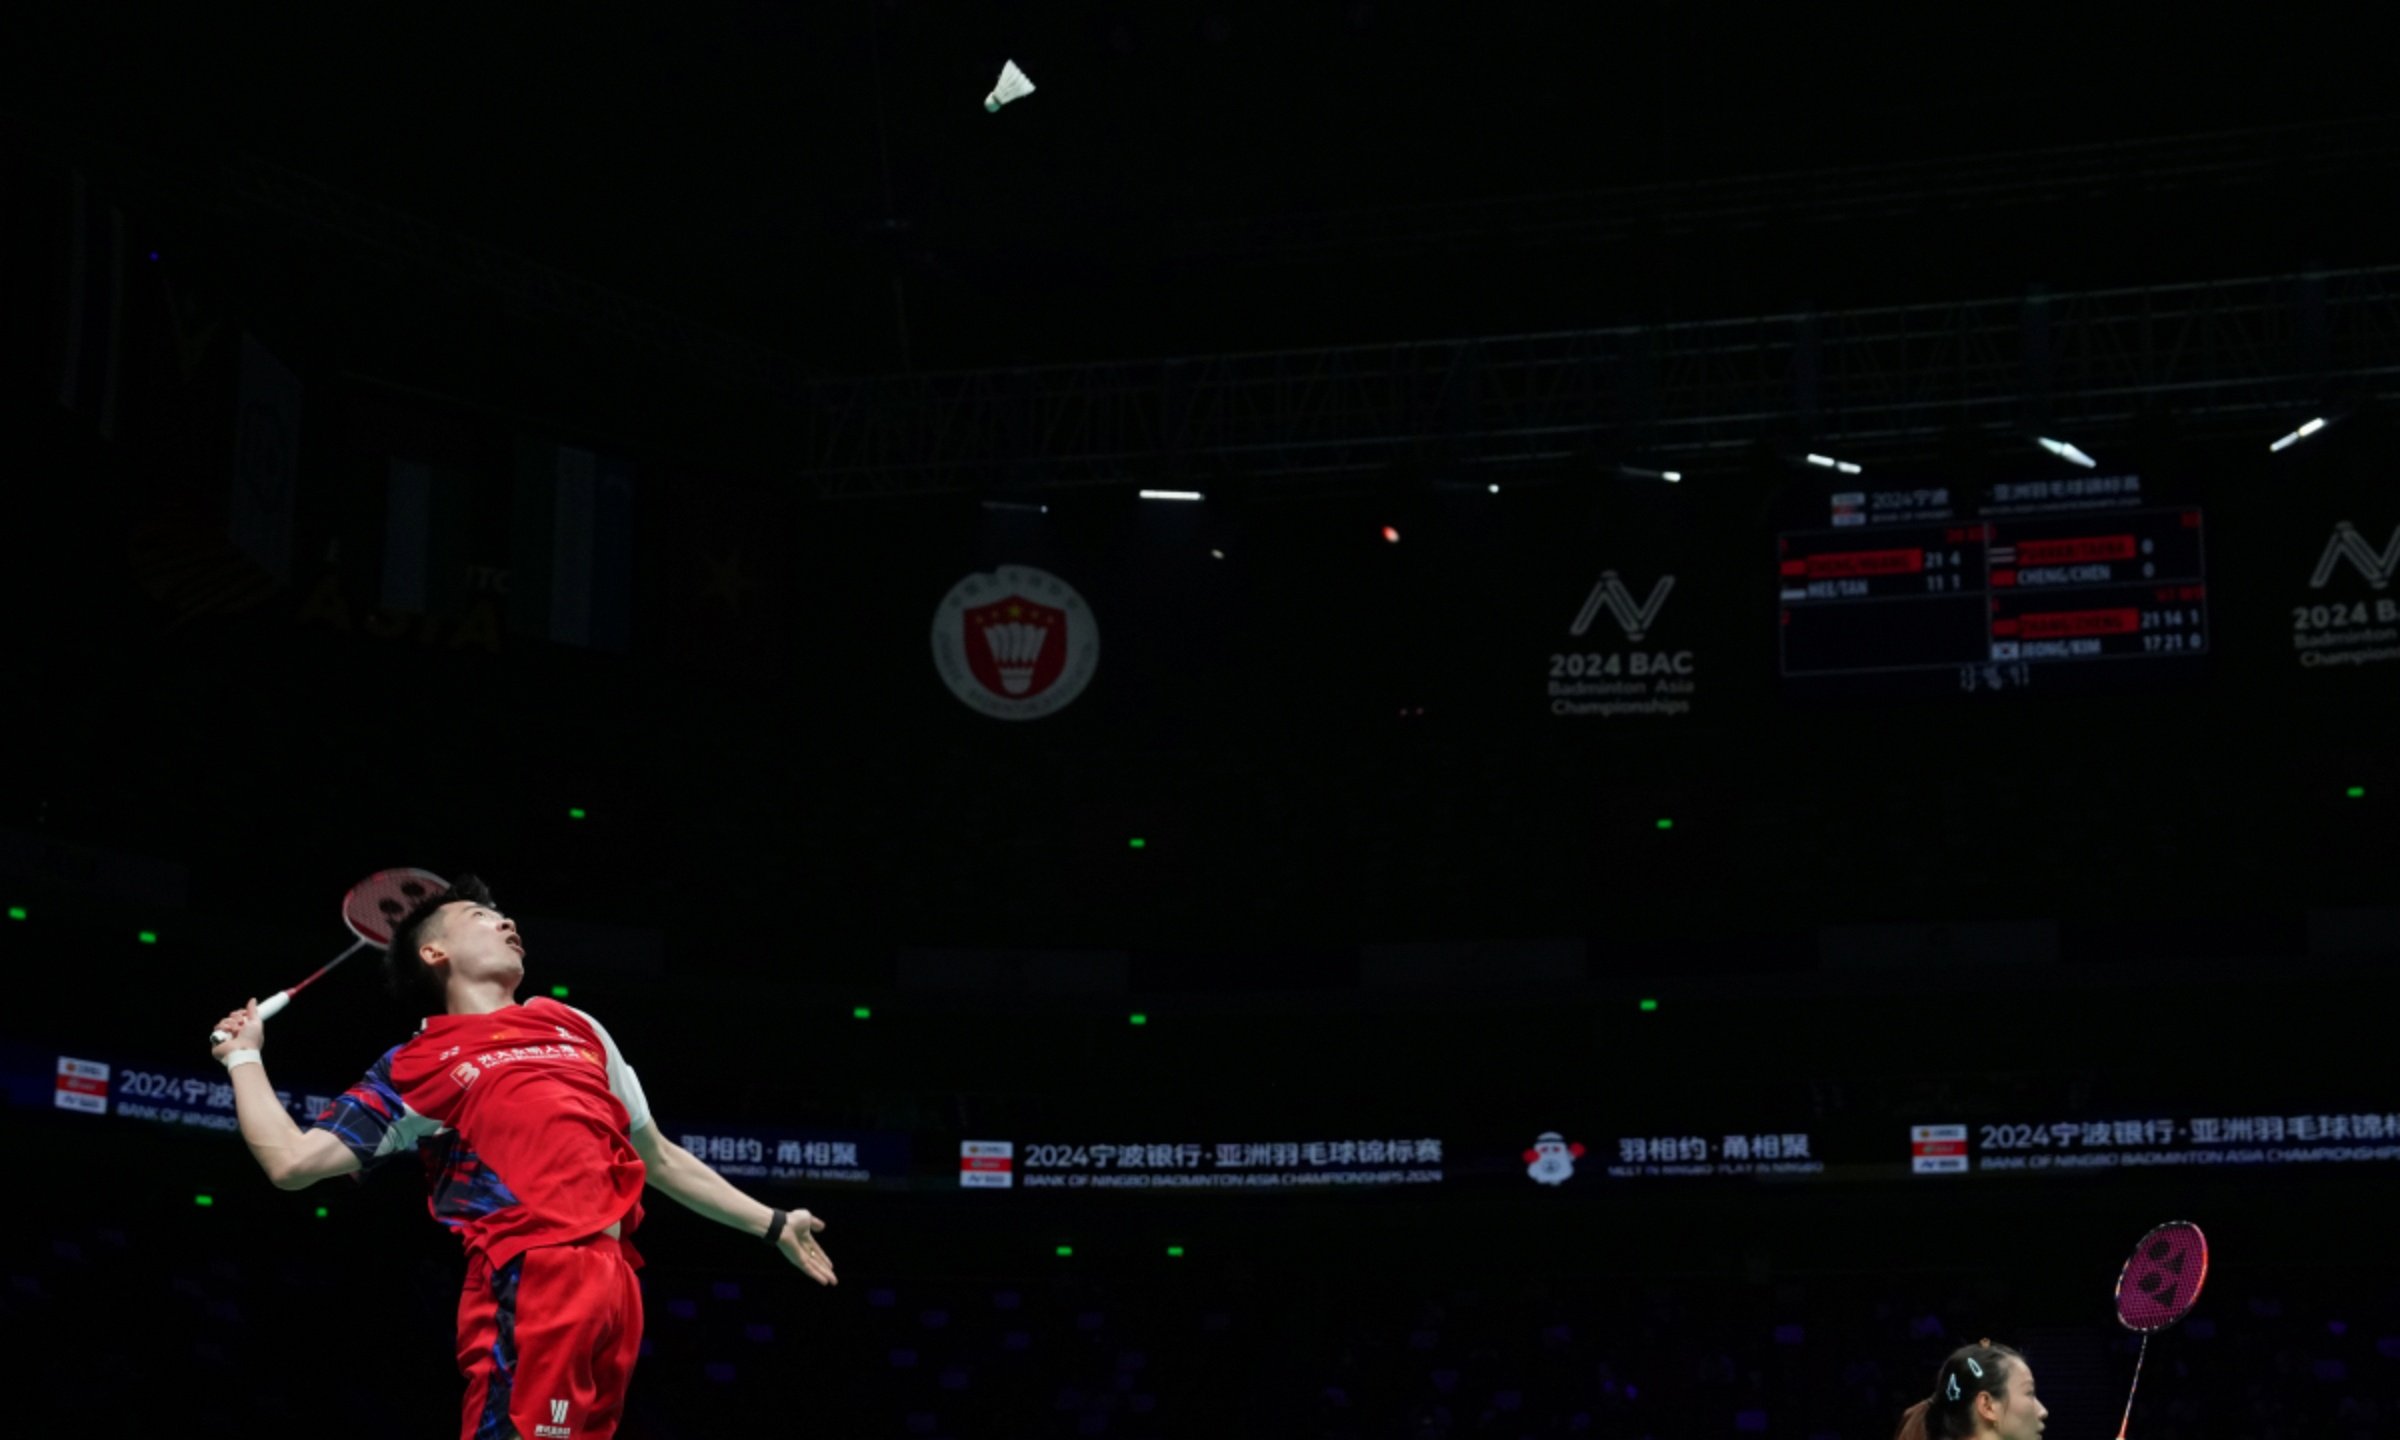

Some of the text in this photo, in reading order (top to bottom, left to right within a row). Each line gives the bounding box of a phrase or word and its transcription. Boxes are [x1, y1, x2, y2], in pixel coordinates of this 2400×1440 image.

[1925, 551, 1943, 568] 21
[2292, 601, 2369, 630] 2024
[1549, 650, 1694, 677] 2024 BAC
[1548, 678, 1695, 697] Badminton Asia
[1550, 697, 1691, 717] Championships
[117, 1102, 159, 1120] BANK
[160, 1106, 179, 1123] OF
[1024, 1138, 1442, 1168] 2024宁波银行·亚洲羽毛球锦标赛
[1023, 1173, 1065, 1187] BANK
[1067, 1173, 1090, 1187] OF
